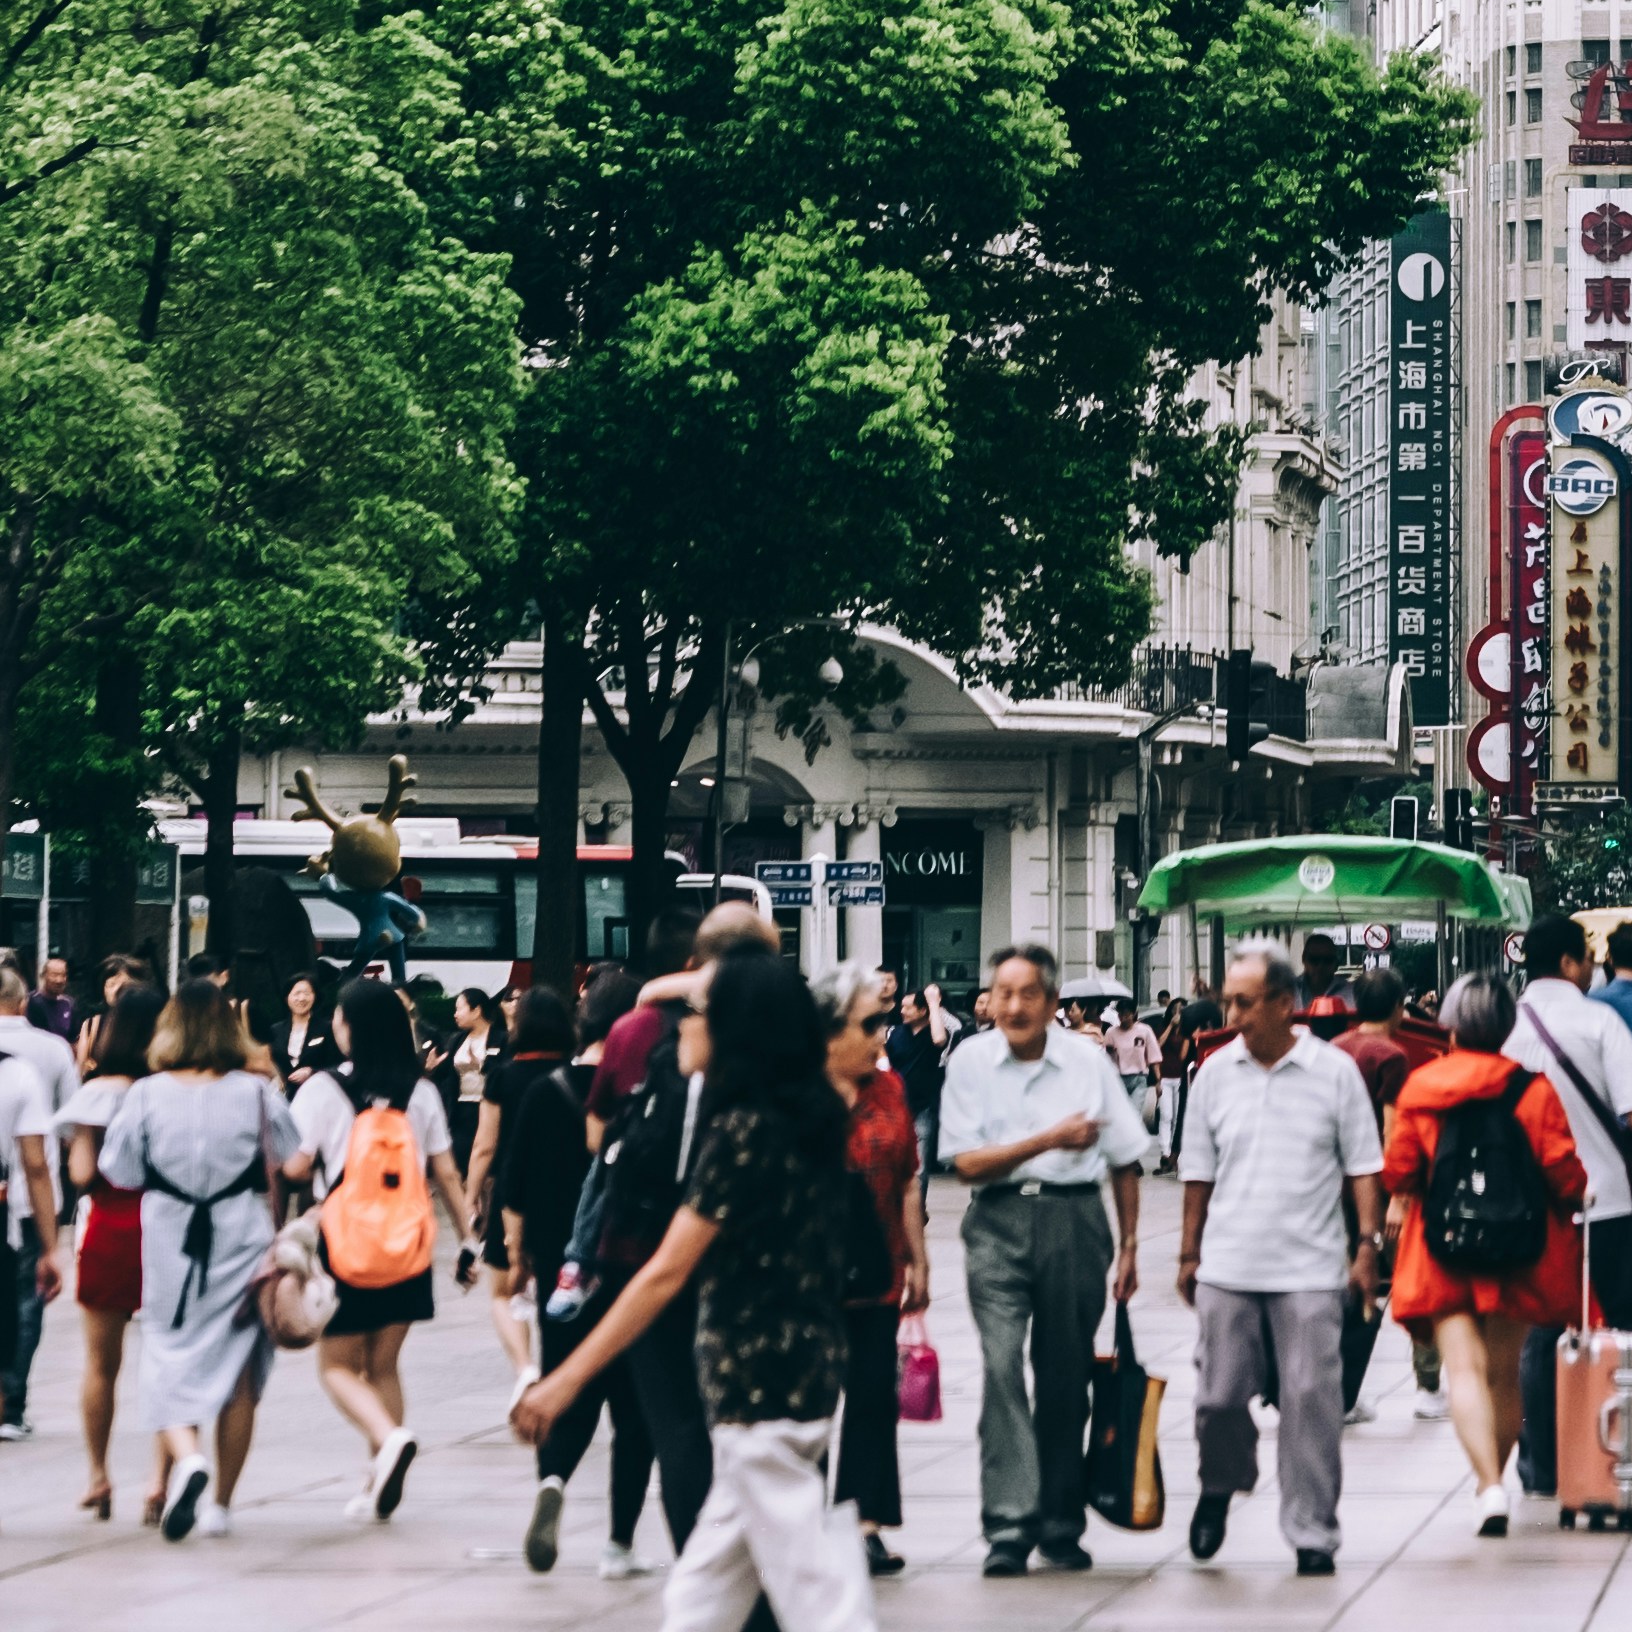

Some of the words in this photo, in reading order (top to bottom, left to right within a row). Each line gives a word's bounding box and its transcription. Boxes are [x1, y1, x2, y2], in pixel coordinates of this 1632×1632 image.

[1432, 319, 1443, 417] SHANGHAI
[1432, 430, 1442, 467] NO.1
[1550, 478, 1614, 495] BAC
[1398, 320, 1427, 677] 上海市第一百货商店
[1432, 483, 1442, 604] DEPARTMENT
[1432, 617, 1442, 678] STORE
